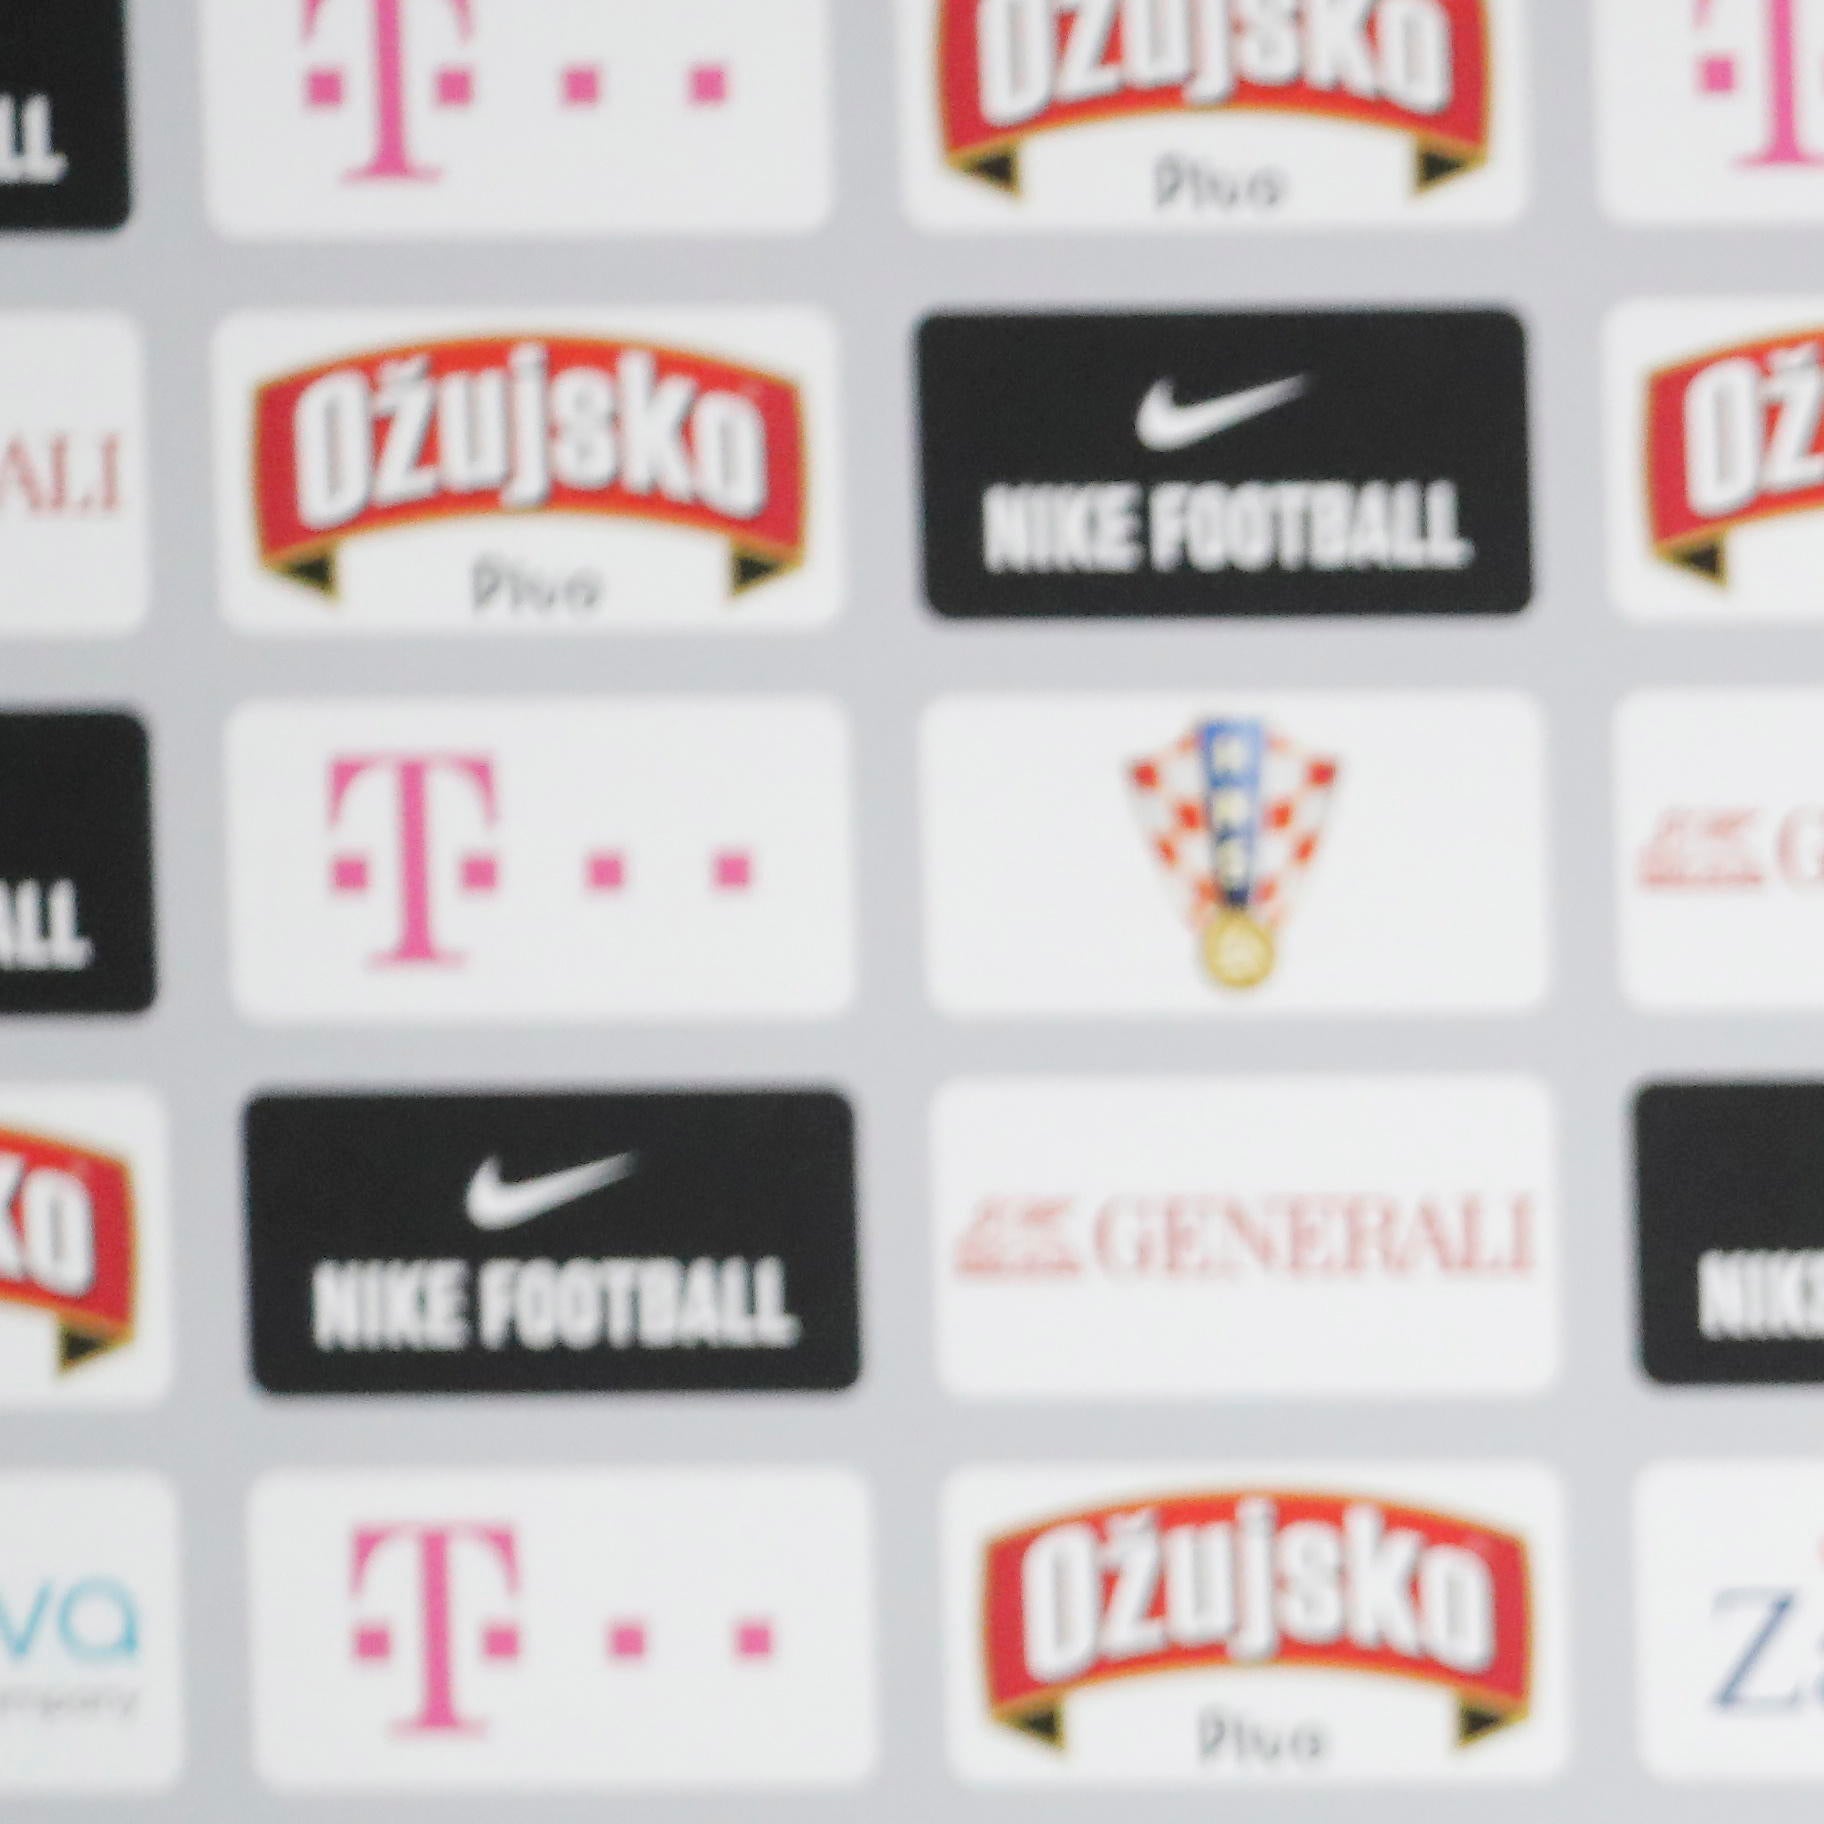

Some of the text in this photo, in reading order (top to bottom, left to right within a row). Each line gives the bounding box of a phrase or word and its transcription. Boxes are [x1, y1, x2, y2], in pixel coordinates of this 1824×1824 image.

[293, 344, 769, 529] Ožujsko
[979, 477, 1476, 576] NIKE FOOTBALL
[1091, 1193, 1535, 1281] GENERALI
[309, 1254, 803, 1354] NIKE FOOTBALL
[1022, 1498, 1496, 1684] Ožujsko
